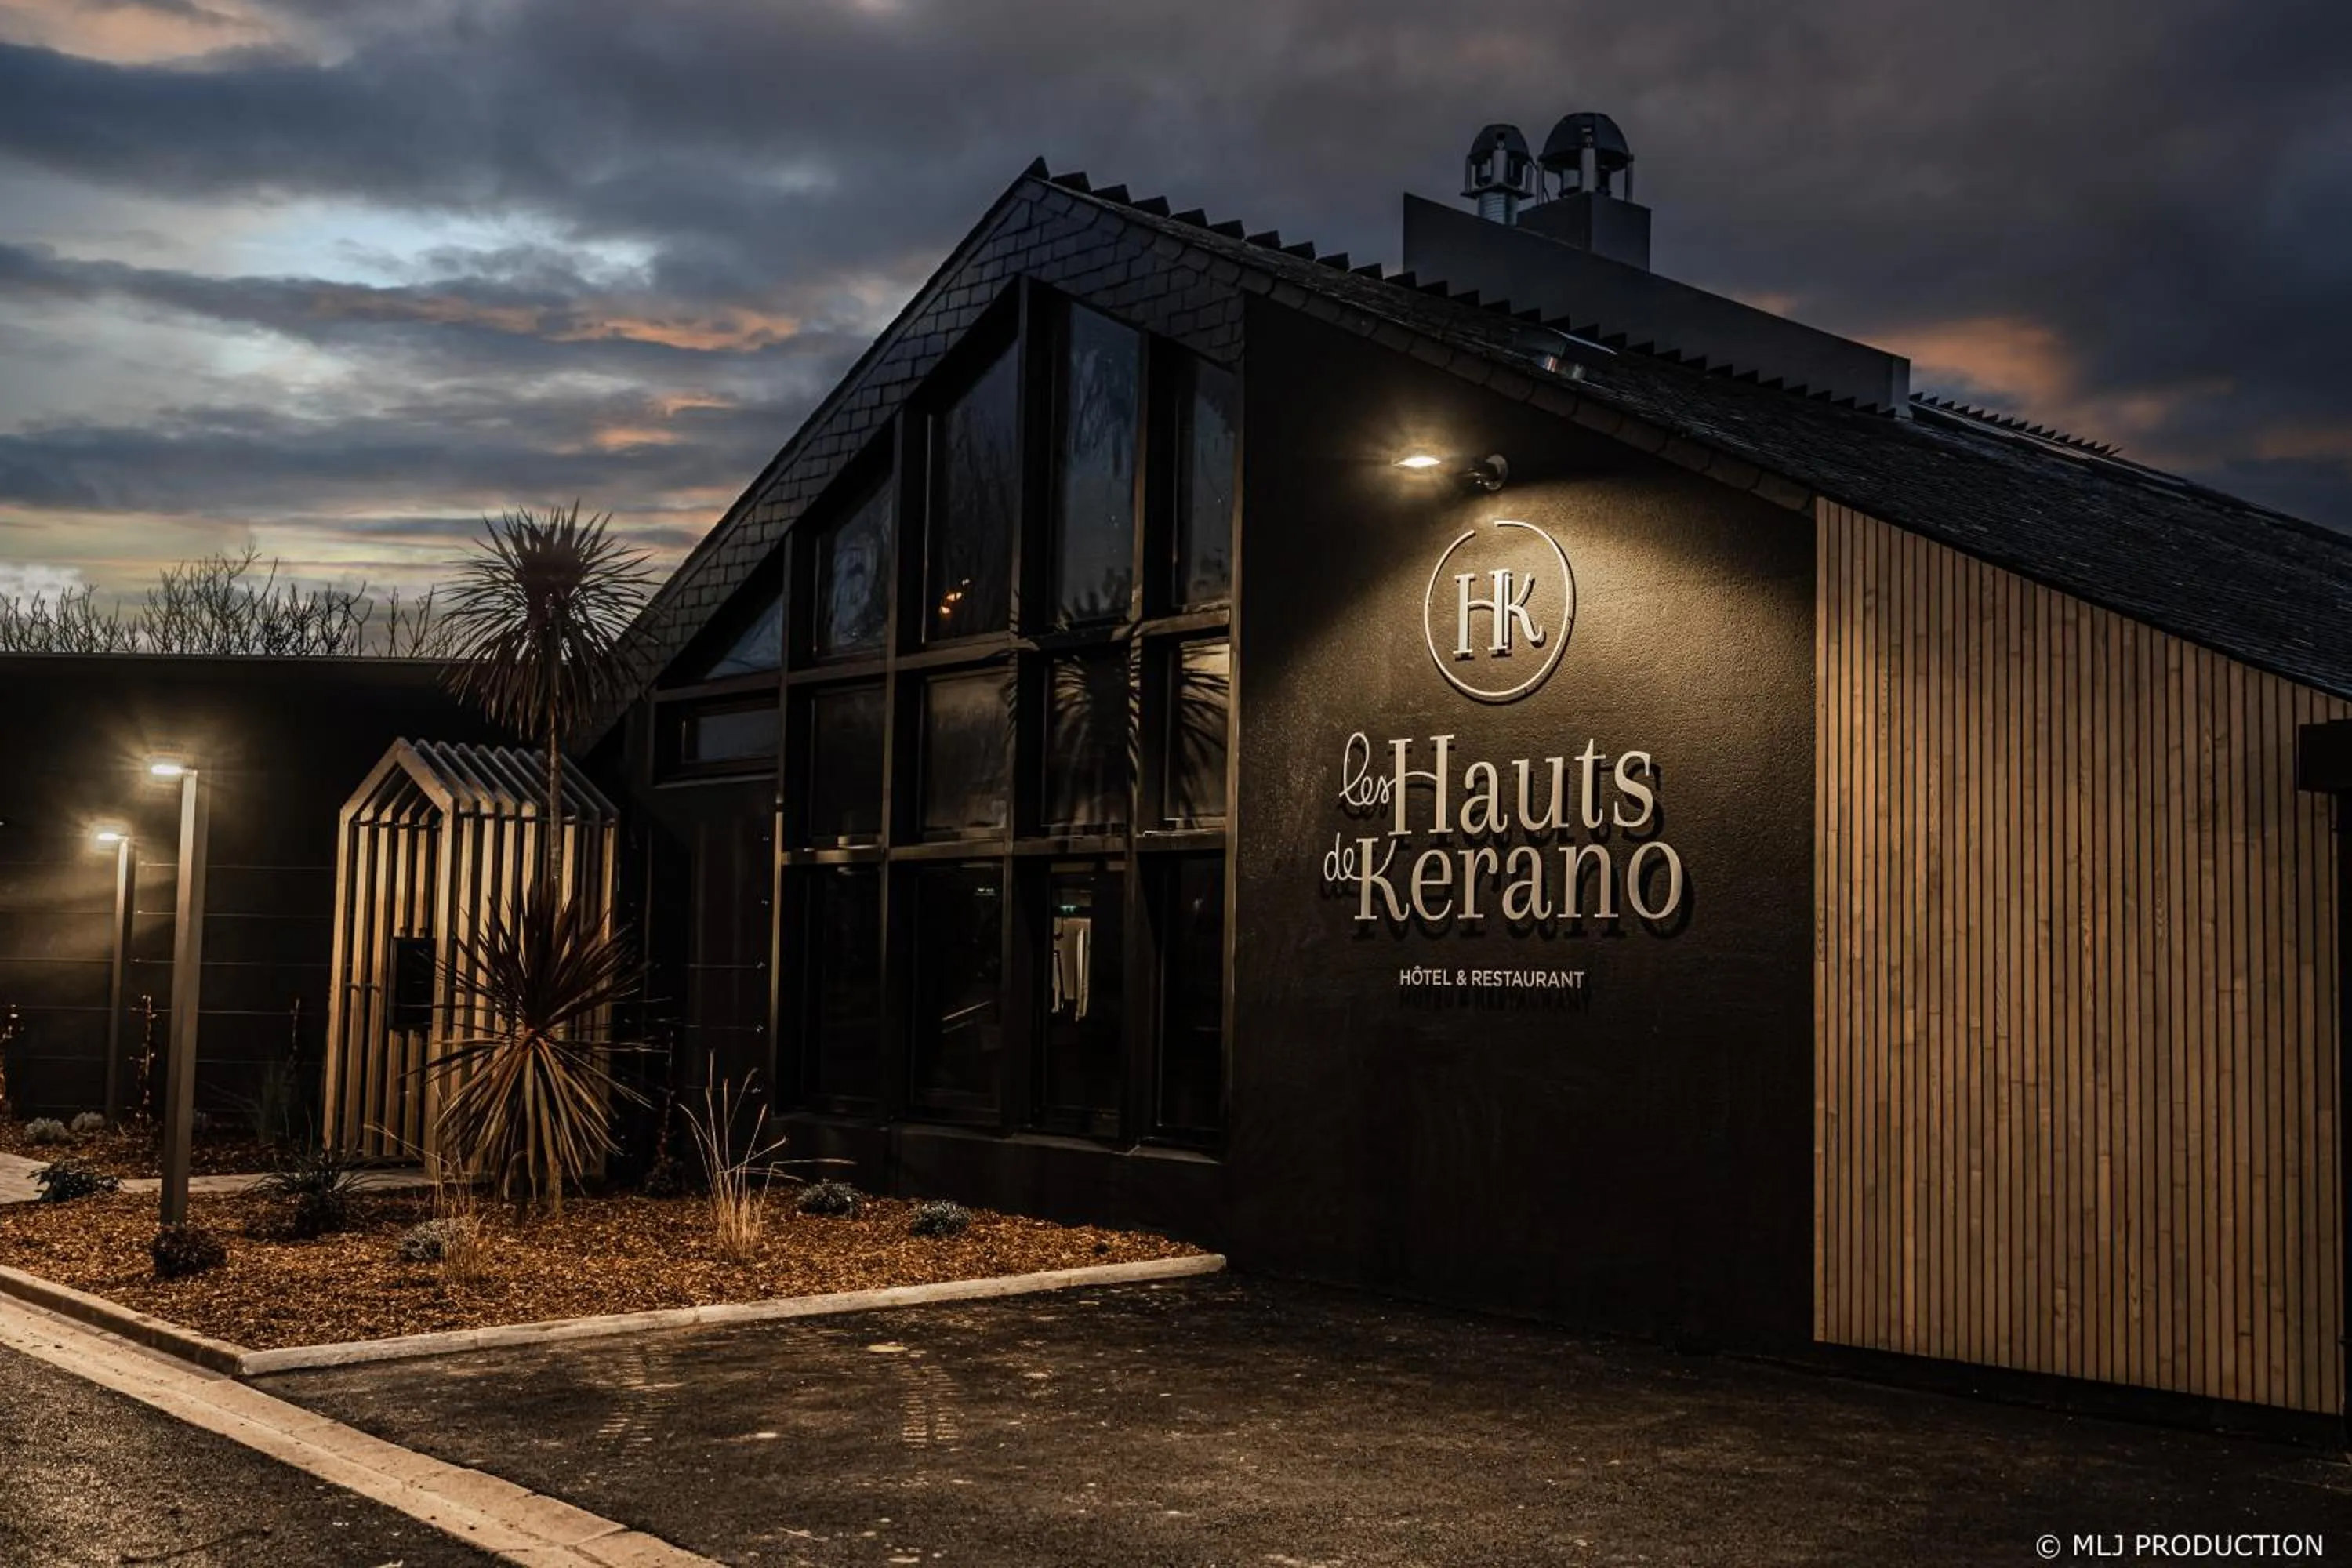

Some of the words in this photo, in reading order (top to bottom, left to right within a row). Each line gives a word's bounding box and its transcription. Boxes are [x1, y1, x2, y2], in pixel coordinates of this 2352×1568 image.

[1339, 731, 1390, 807] les
[1388, 734, 1651, 836] Hauts
[1323, 832, 1358, 881] de
[1354, 837, 1683, 922] Kerano
[1399, 965, 1451, 986] HÔTEL
[1456, 969, 1467, 986] &
[1472, 969, 1584, 989] RESTAURANT
